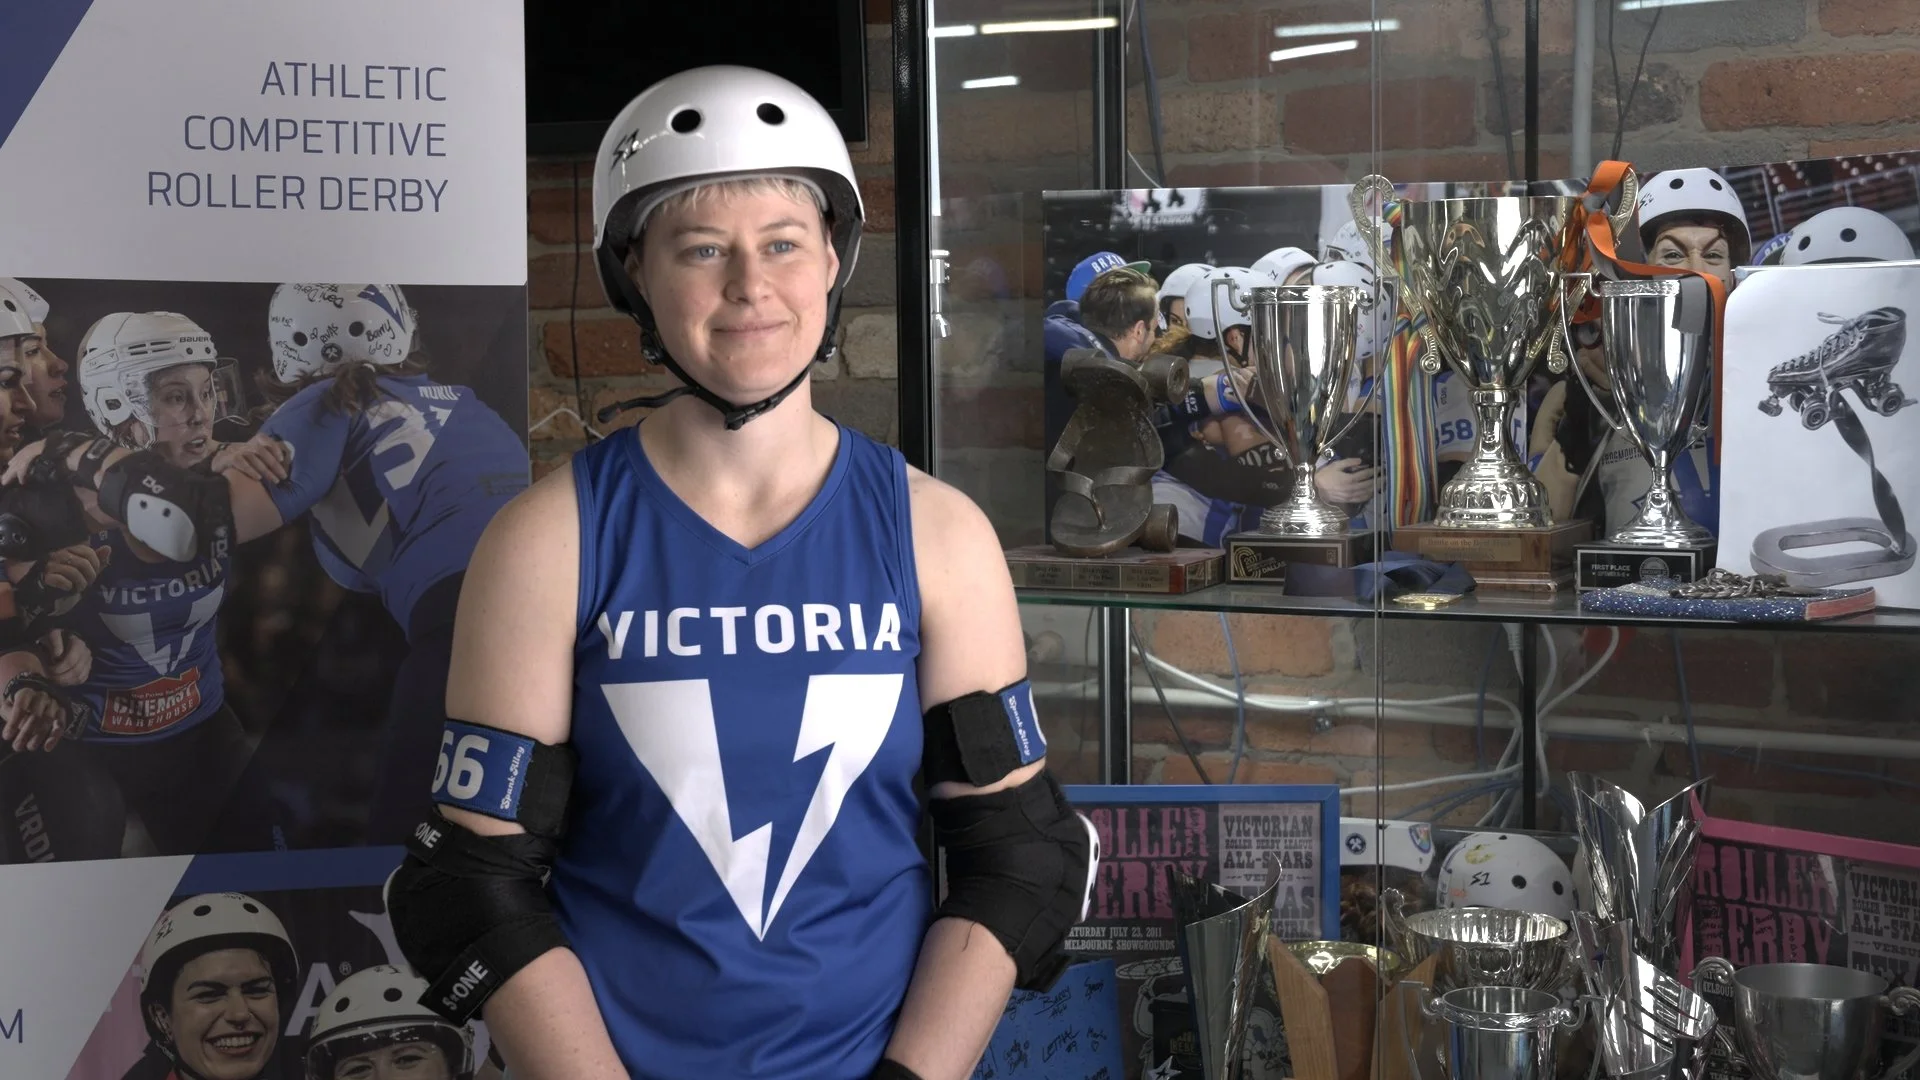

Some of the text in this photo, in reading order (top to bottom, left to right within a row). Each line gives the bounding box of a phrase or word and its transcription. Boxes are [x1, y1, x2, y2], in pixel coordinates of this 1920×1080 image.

[261, 61, 447, 101] ATHLETIC
[184, 115, 447, 157] COMPETITIVE
[148, 171, 449, 213] ROLLER DERBY
[1435, 418, 1473, 450] 58
[99, 557, 223, 605] VICTORIA
[1591, 563, 1610, 571] FIRST
[598, 603, 902, 660] VICTORIA
[1078, 806, 1210, 859] OLLER
[1223, 815, 1313, 837] VICTORIAN
[1225, 839, 1313, 849] ROLLER DERBY LEAGUE
[1697, 843, 1838, 916] ROLLER
[1850, 872, 1920, 907] VICTORI
[1851, 898, 1881, 915] ROLLER
[1884, 904, 1910, 919] DERBY
[1064, 939, 1175, 951] MELBOURNE SHOWGROUNDS
[1068, 926, 1108, 938] ATURDAY
[1110, 926, 1128, 938] JULY
[1146, 927, 1162, 937] 2011
[1872, 941, 1920, 958] VERSU
